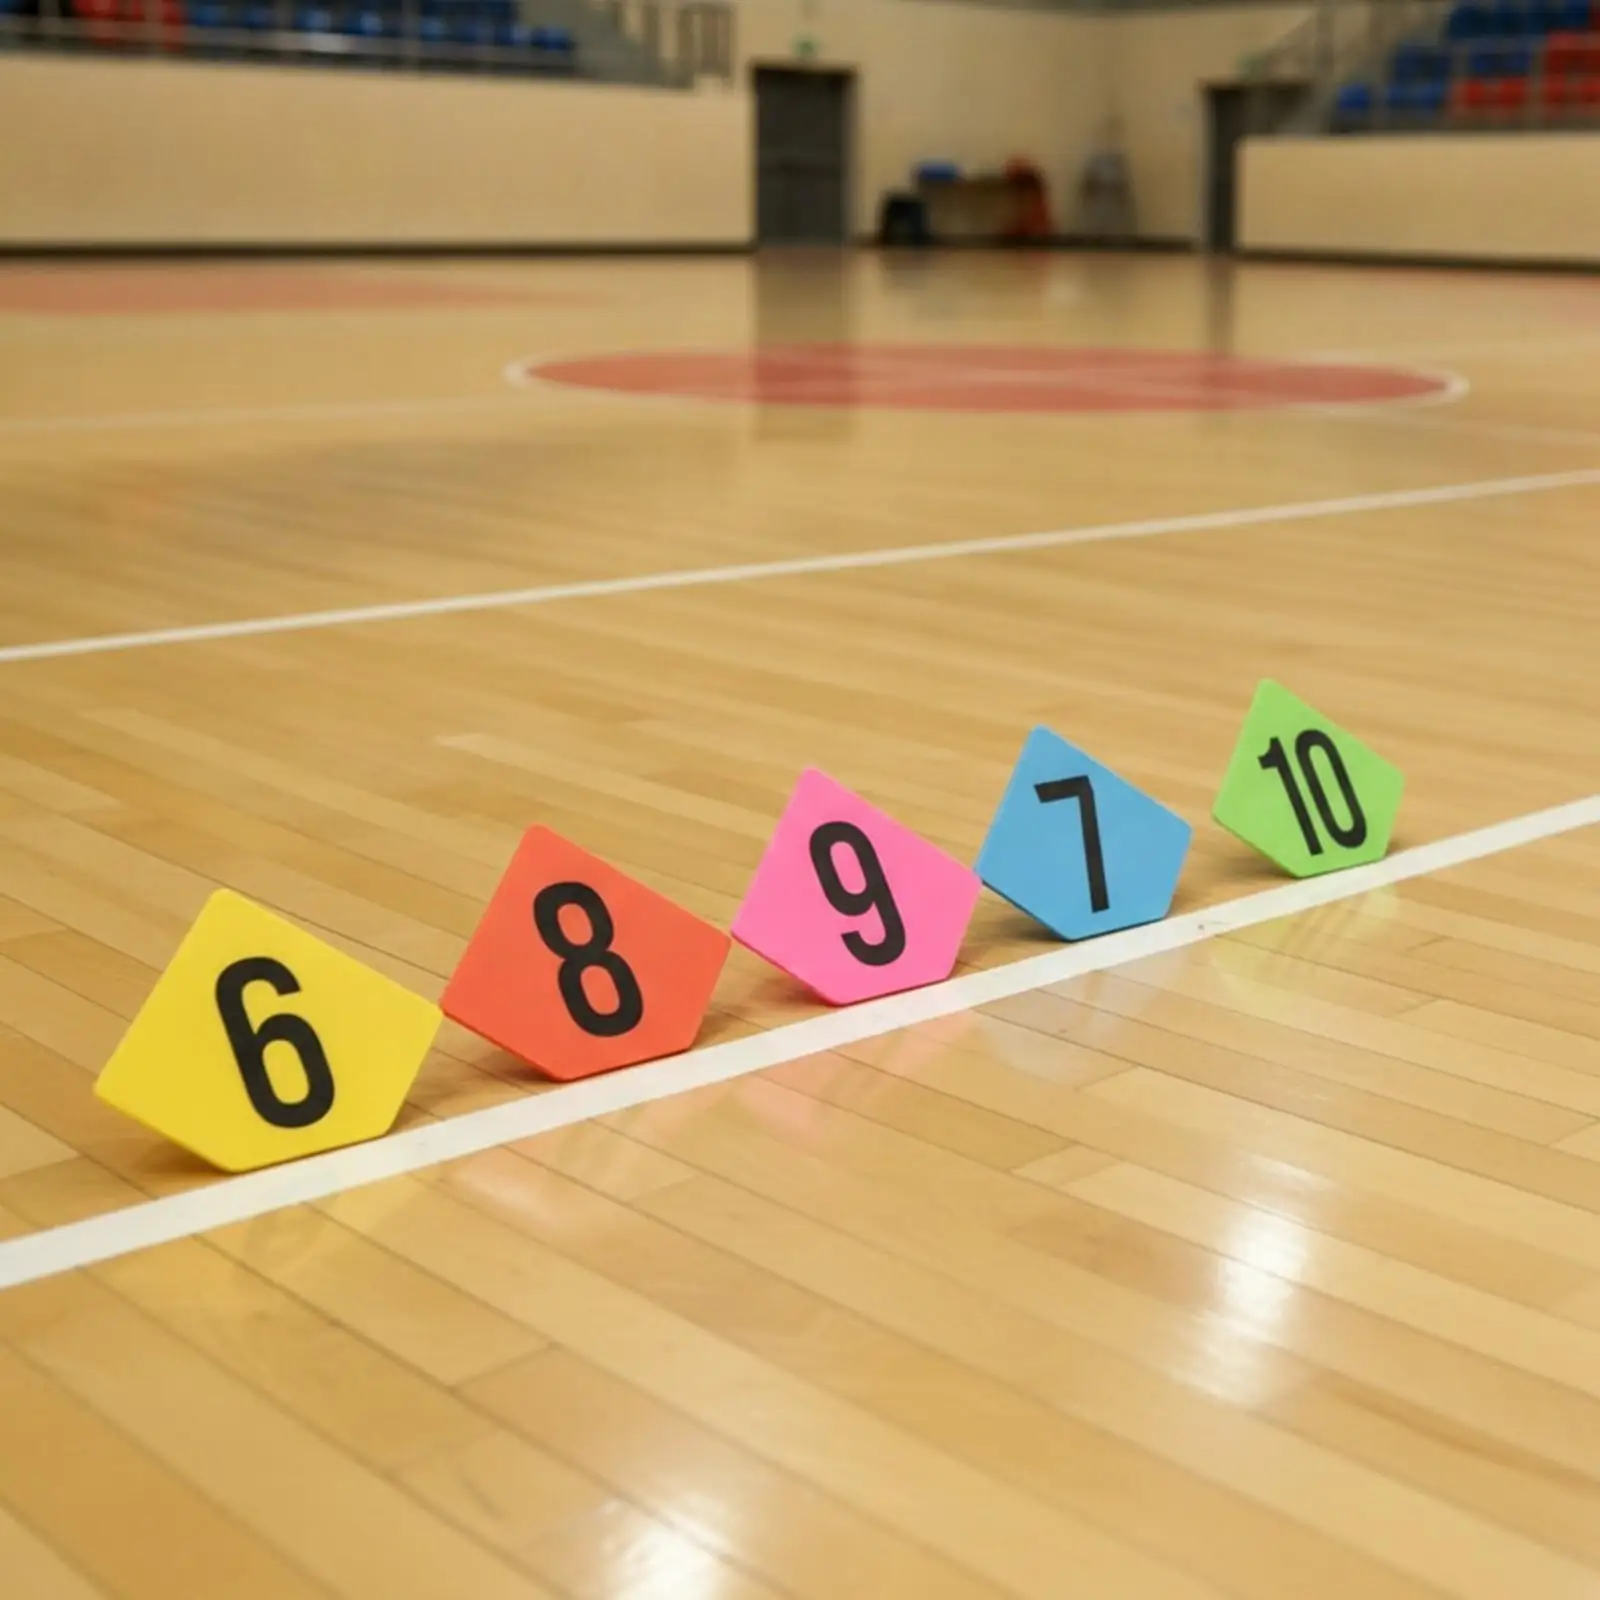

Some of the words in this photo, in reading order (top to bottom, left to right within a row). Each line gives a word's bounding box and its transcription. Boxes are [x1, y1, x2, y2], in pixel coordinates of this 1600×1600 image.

[1034, 775, 1110, 913] 7
[1258, 729, 1367, 856] 10
[532, 881, 644, 1038] 8
[809, 821, 907, 967] 9
[214, 956, 336, 1129] 6
